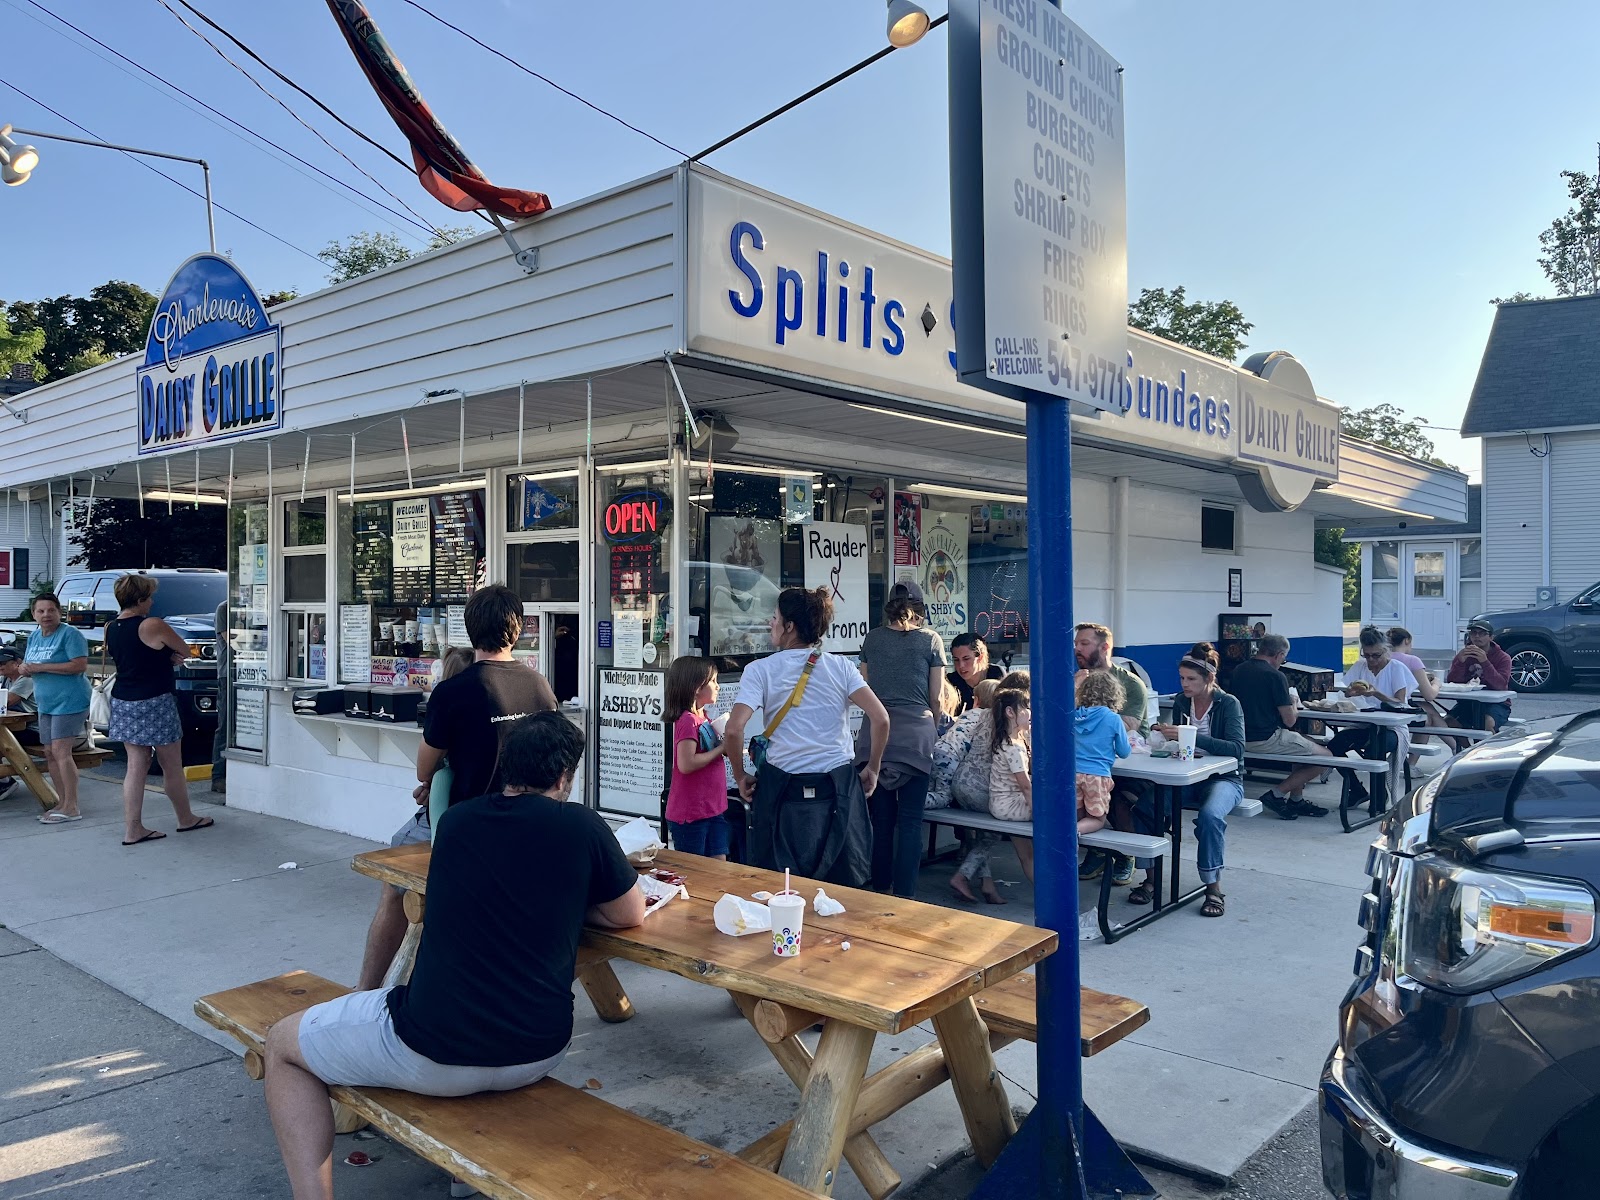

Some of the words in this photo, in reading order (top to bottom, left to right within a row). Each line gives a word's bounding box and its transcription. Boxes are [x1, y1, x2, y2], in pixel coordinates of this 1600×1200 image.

[984, 0, 1037, 37] ESH
[1043, 9, 1083, 72] MEAT
[1088, 45, 1121, 103] DAILY
[997, 24, 1064, 101] GROUND
[1069, 75, 1114, 139] CHUCK
[1026, 90, 1094, 167] BURGERS
[1034, 142, 1090, 208] CONEYS
[1014, 178, 1075, 240] SHRIMP
[1081, 213, 1106, 259] BOX
[1043, 239, 1084, 291] FRIES
[729, 222, 906, 356] Splits
[1043, 285, 1087, 336] RINGS
[154, 282, 259, 373] Charlevoix
[995, 337, 1038, 355] CALL-INS
[994, 357, 1043, 376] WELCOME
[1048, 338, 1124, 408] 547-9771
[141, 374, 195, 445] DAIRY
[203, 352, 275, 433] GRILLE
[1245, 391, 1289, 453] DAIRY
[1296, 409, 1335, 465] GRILLE
[396, 504, 427, 515] WELCOME!
[412, 519, 427, 530] GRILLE
[605, 501, 656, 535] OPEN
[809, 531, 867, 573] Rayder
[924, 602, 966, 626] ASHBY'S
[974, 610, 1029, 638] OPEN
[237, 666, 267, 680] ASHBY'S
[604, 671, 637, 686] Michigan
[638, 672, 658, 686] Made
[601, 694, 661, 715] ASHBY'S
[613, 718, 632, 729] Dipped
[633, 720, 642, 730] Ice
[643, 721, 661, 731] Cream
